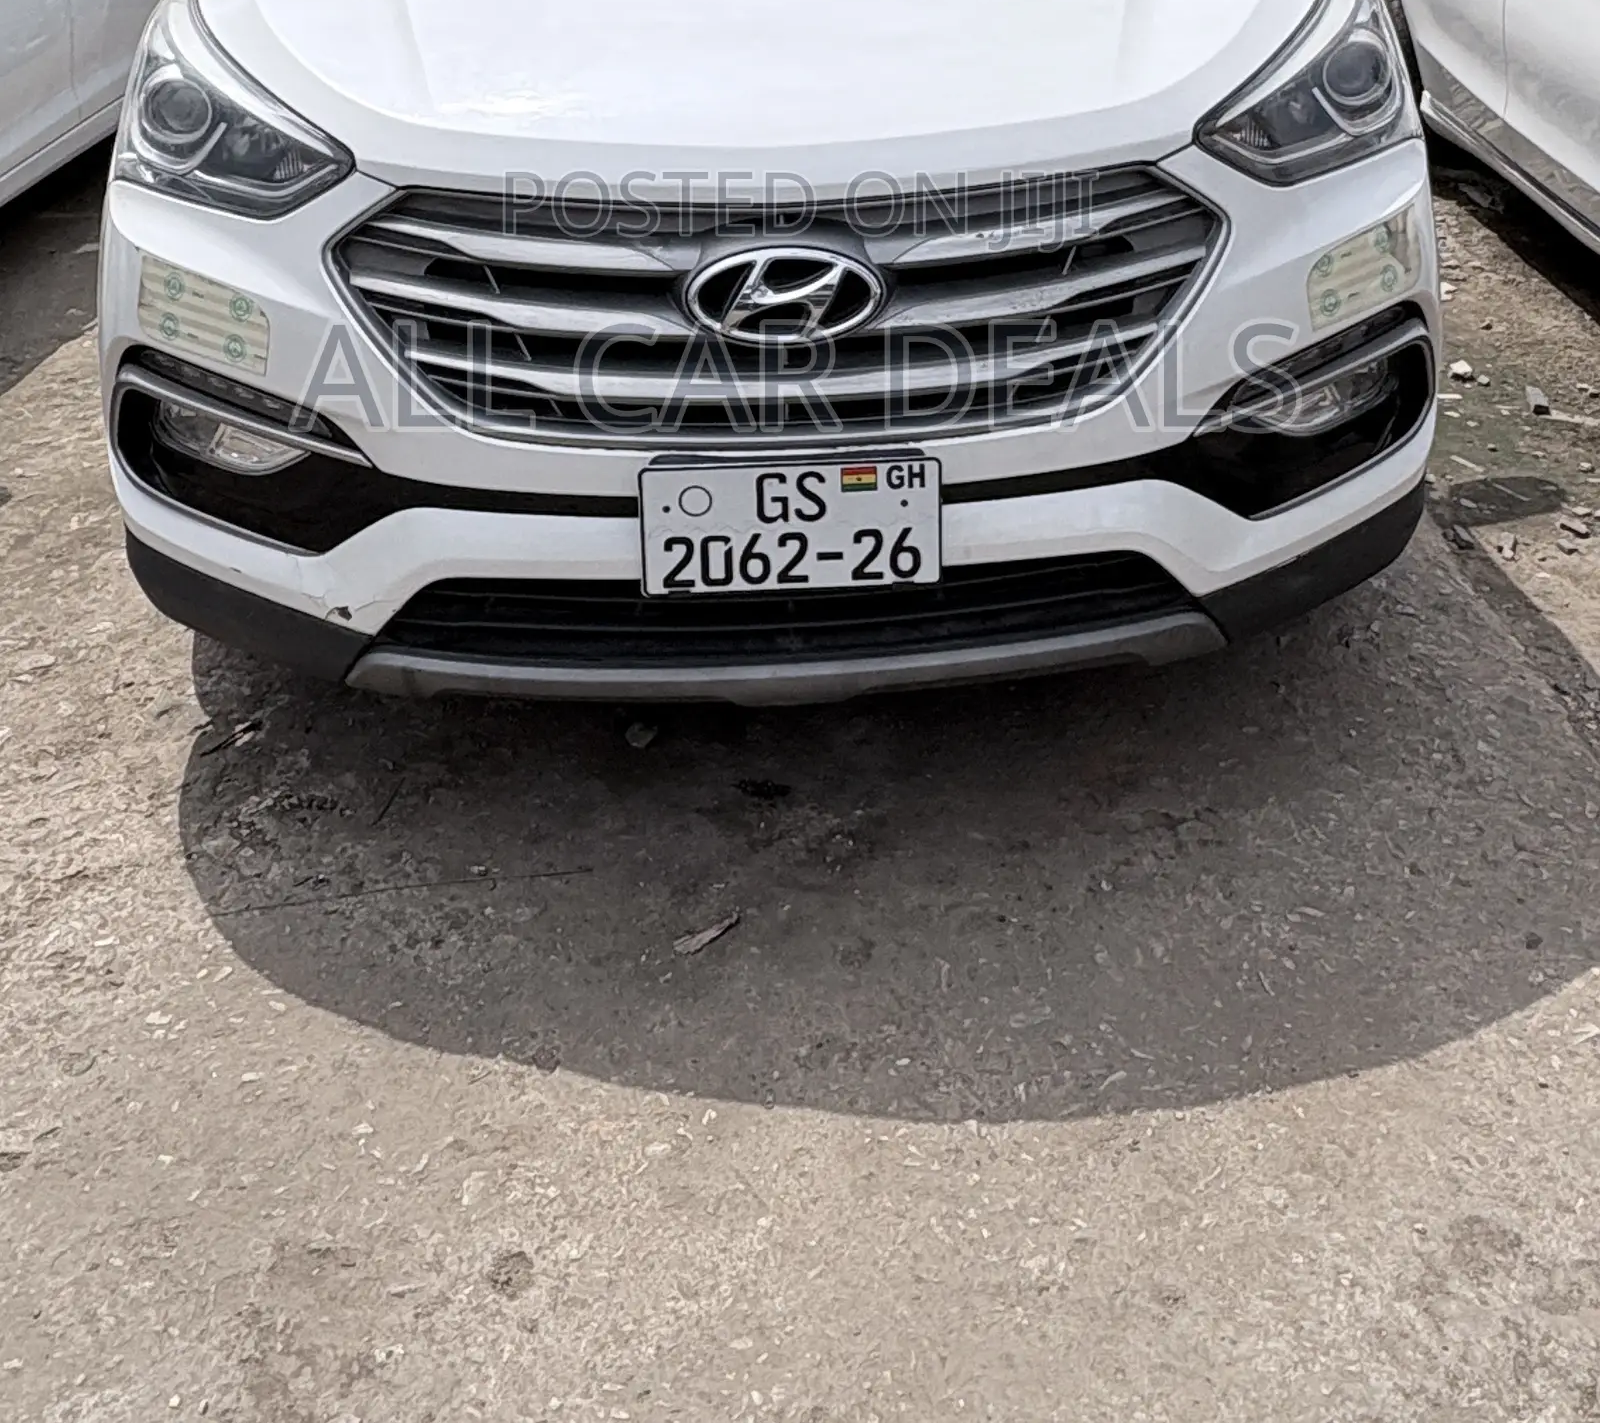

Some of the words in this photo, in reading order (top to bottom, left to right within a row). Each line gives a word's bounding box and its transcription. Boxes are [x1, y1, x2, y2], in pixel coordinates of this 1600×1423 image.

[755, 471, 827, 524] GS
[886, 464, 926, 489] GH
[662, 527, 922, 588] 2062-26
